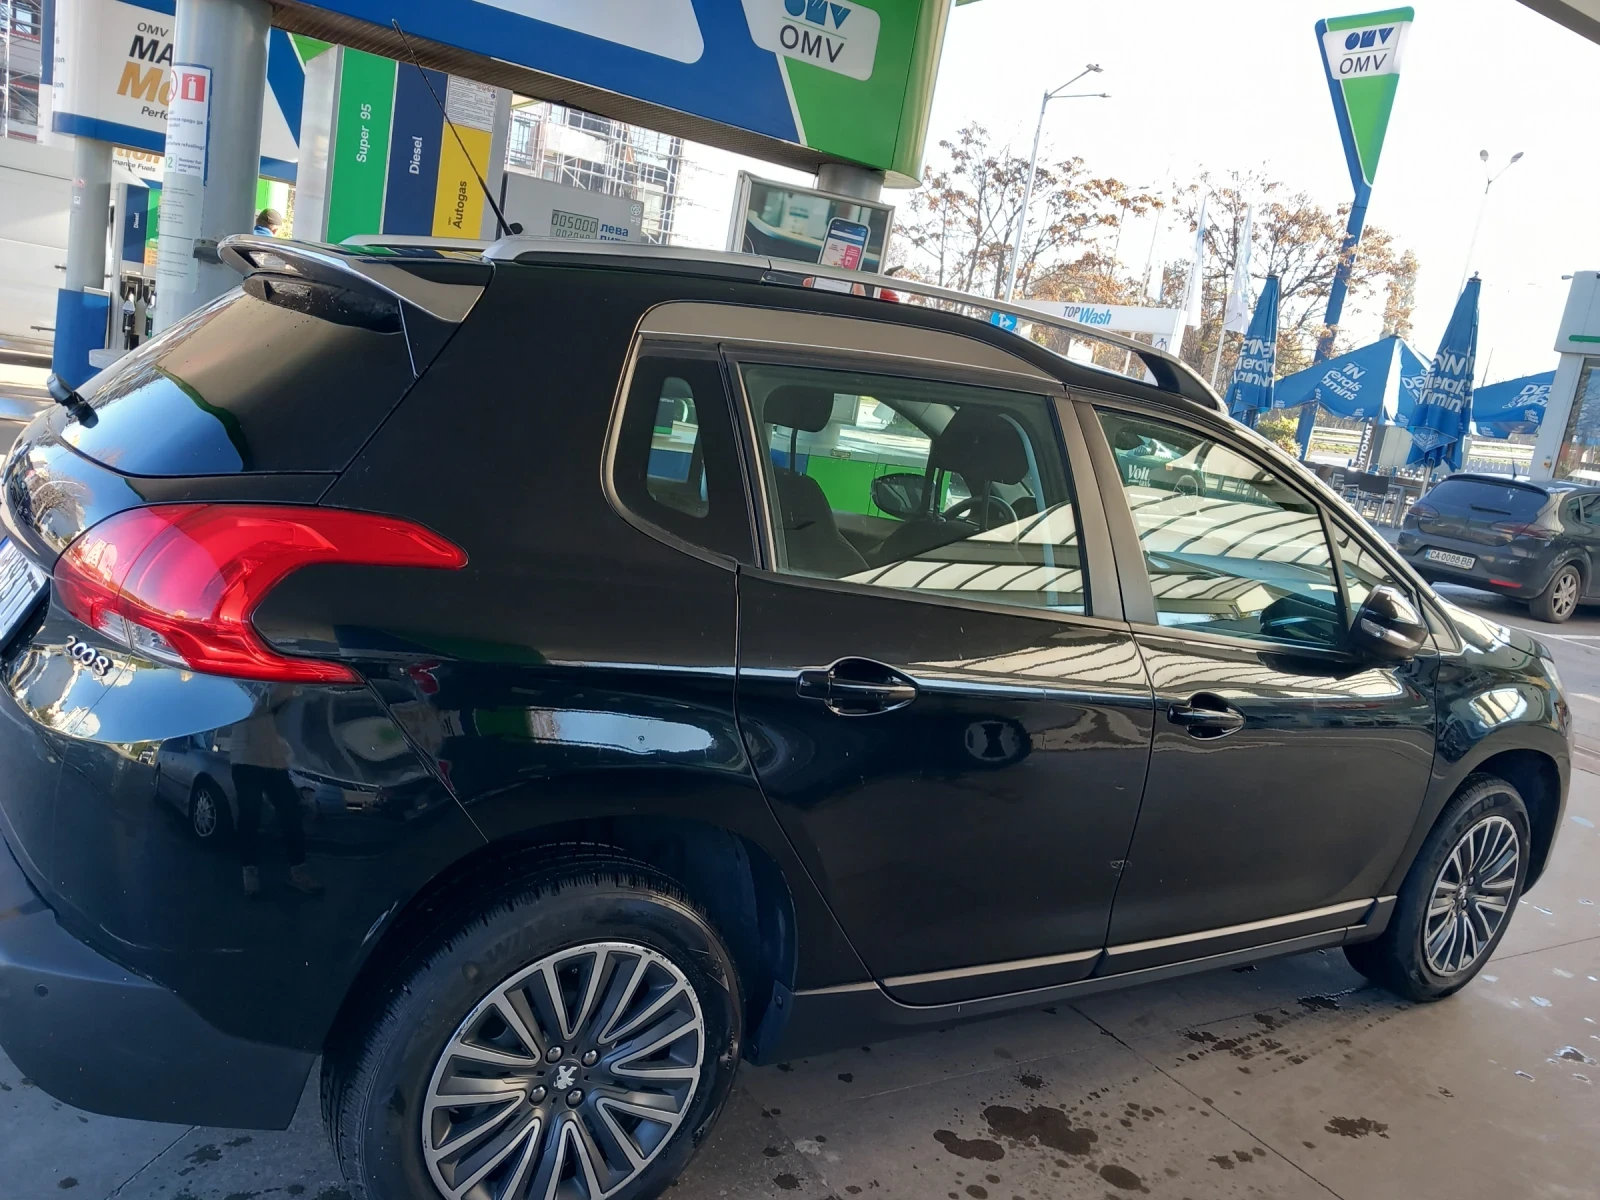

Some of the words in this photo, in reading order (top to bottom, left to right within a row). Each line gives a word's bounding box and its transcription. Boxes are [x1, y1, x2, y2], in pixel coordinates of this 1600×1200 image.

[137, 22, 169, 38] OMV
[129, 34, 174, 67] MA
[780, 24, 845, 64] OMV
[1339, 53, 1388, 75] OMV
[116, 60, 172, 107] Mo
[141, 105, 169, 121] Perfo
[360, 103, 372, 120] 95
[356, 125, 370, 163] Super
[409, 136, 423, 174] Diesel
[137, 163, 156, 172] Fuels
[453, 180, 468, 229] Autogas
[600, 223, 629, 237] лева
[1128, 464, 1149, 480] Volt
[65, 634, 113, 676] 2008
